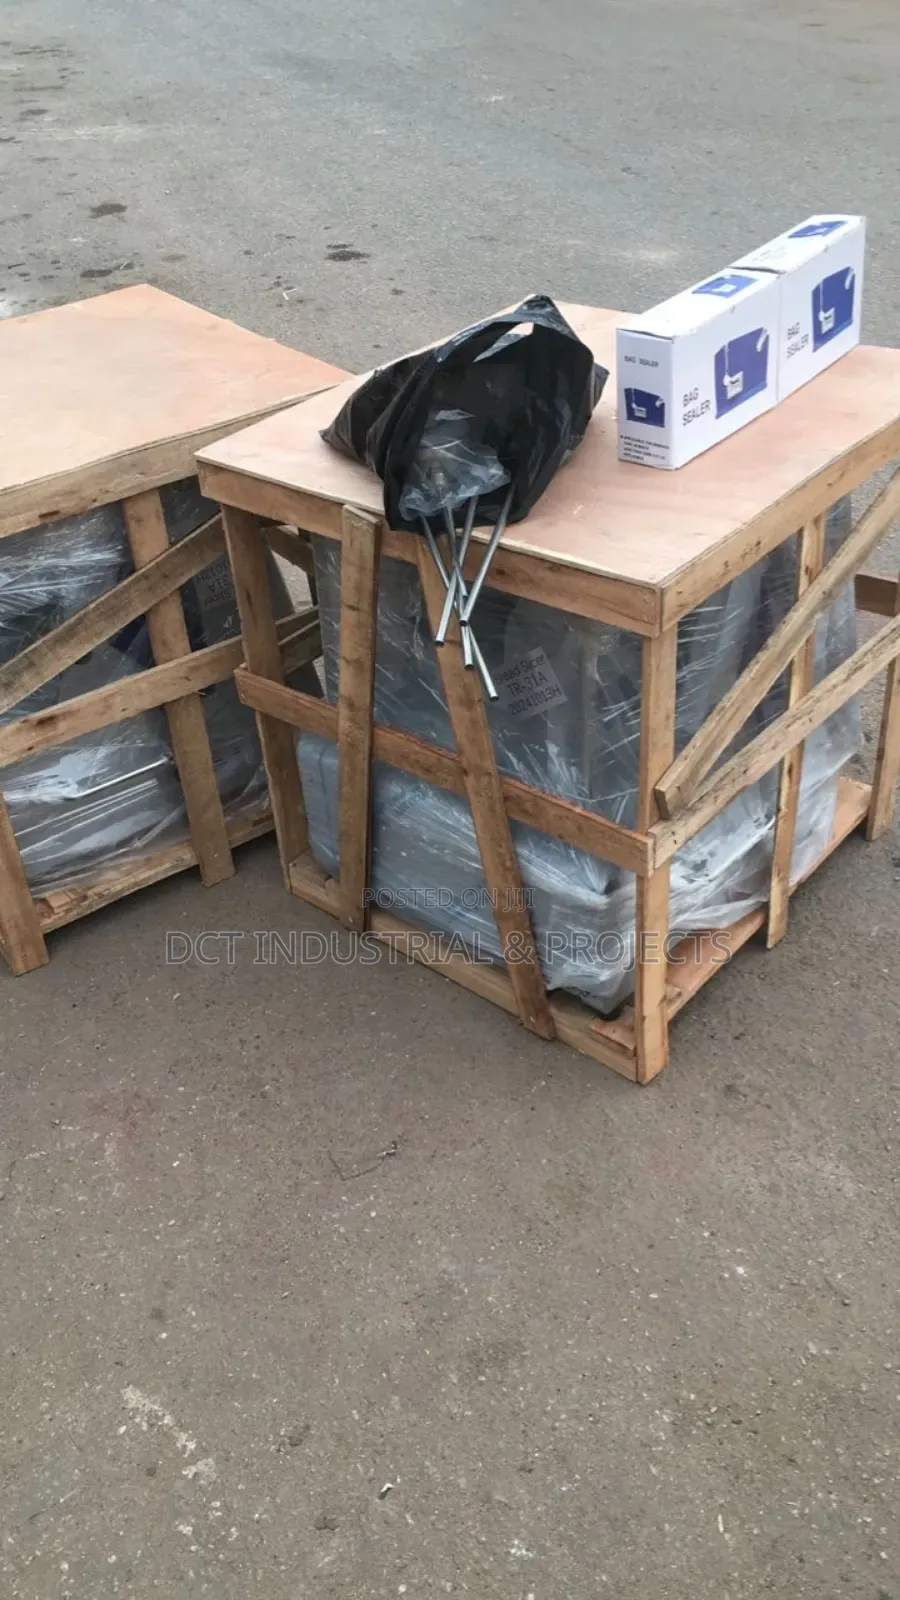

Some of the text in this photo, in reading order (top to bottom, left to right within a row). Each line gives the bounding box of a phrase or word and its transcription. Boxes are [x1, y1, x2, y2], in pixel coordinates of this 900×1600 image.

[787, 321, 800, 340] BAG
[786, 333, 810, 359] SEALER
[682, 387, 699, 407] BAG
[682, 399, 711, 426] SEALER
